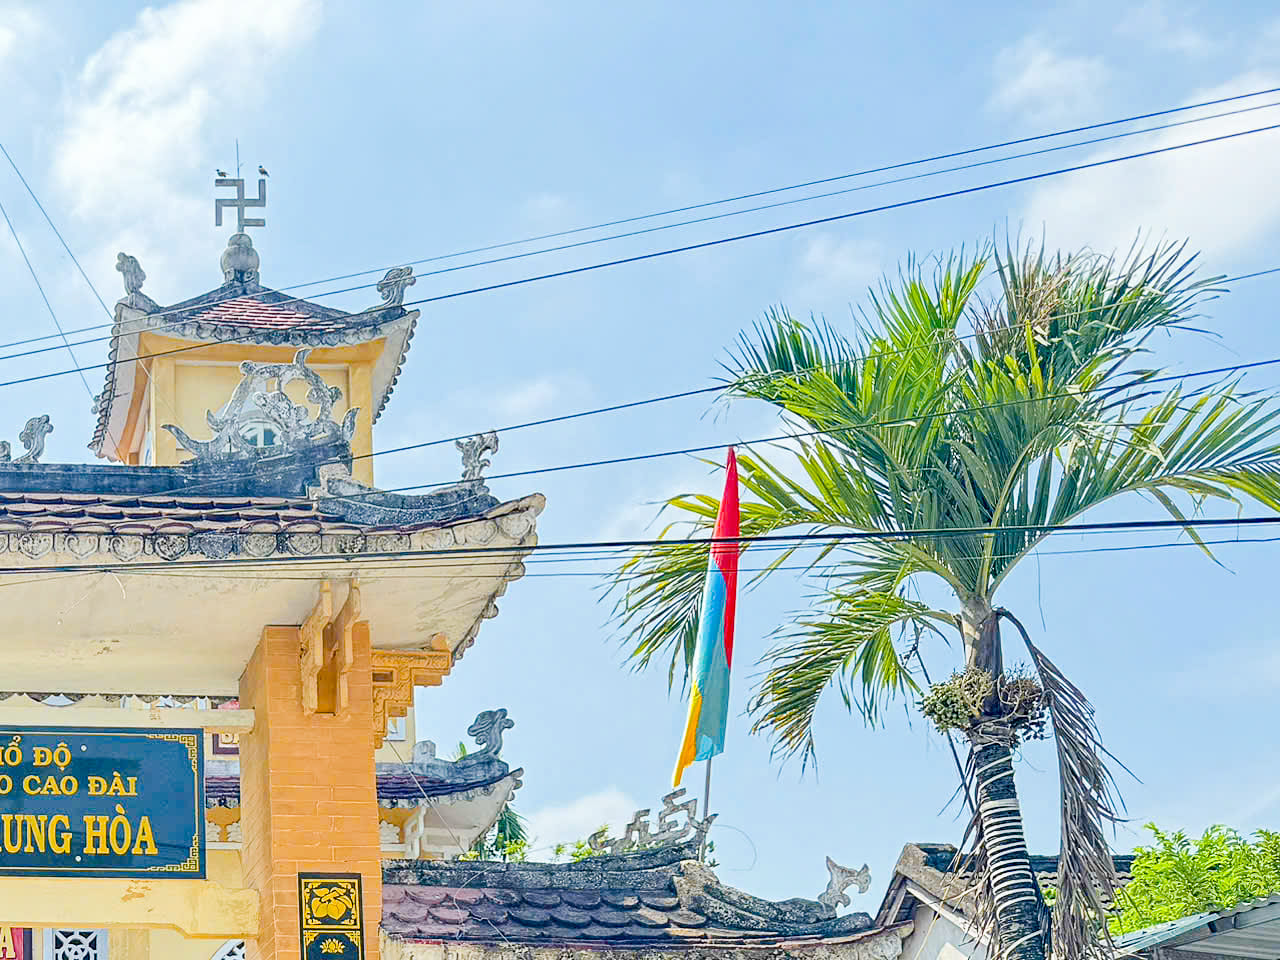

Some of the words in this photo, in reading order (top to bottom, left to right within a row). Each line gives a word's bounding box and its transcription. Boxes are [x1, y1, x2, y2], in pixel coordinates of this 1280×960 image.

[33, 742, 72, 771] ĐỘ
[23, 774, 78, 796] CAO
[88, 771, 137, 797] ĐÀI
[83, 803, 159, 856] HÒA
